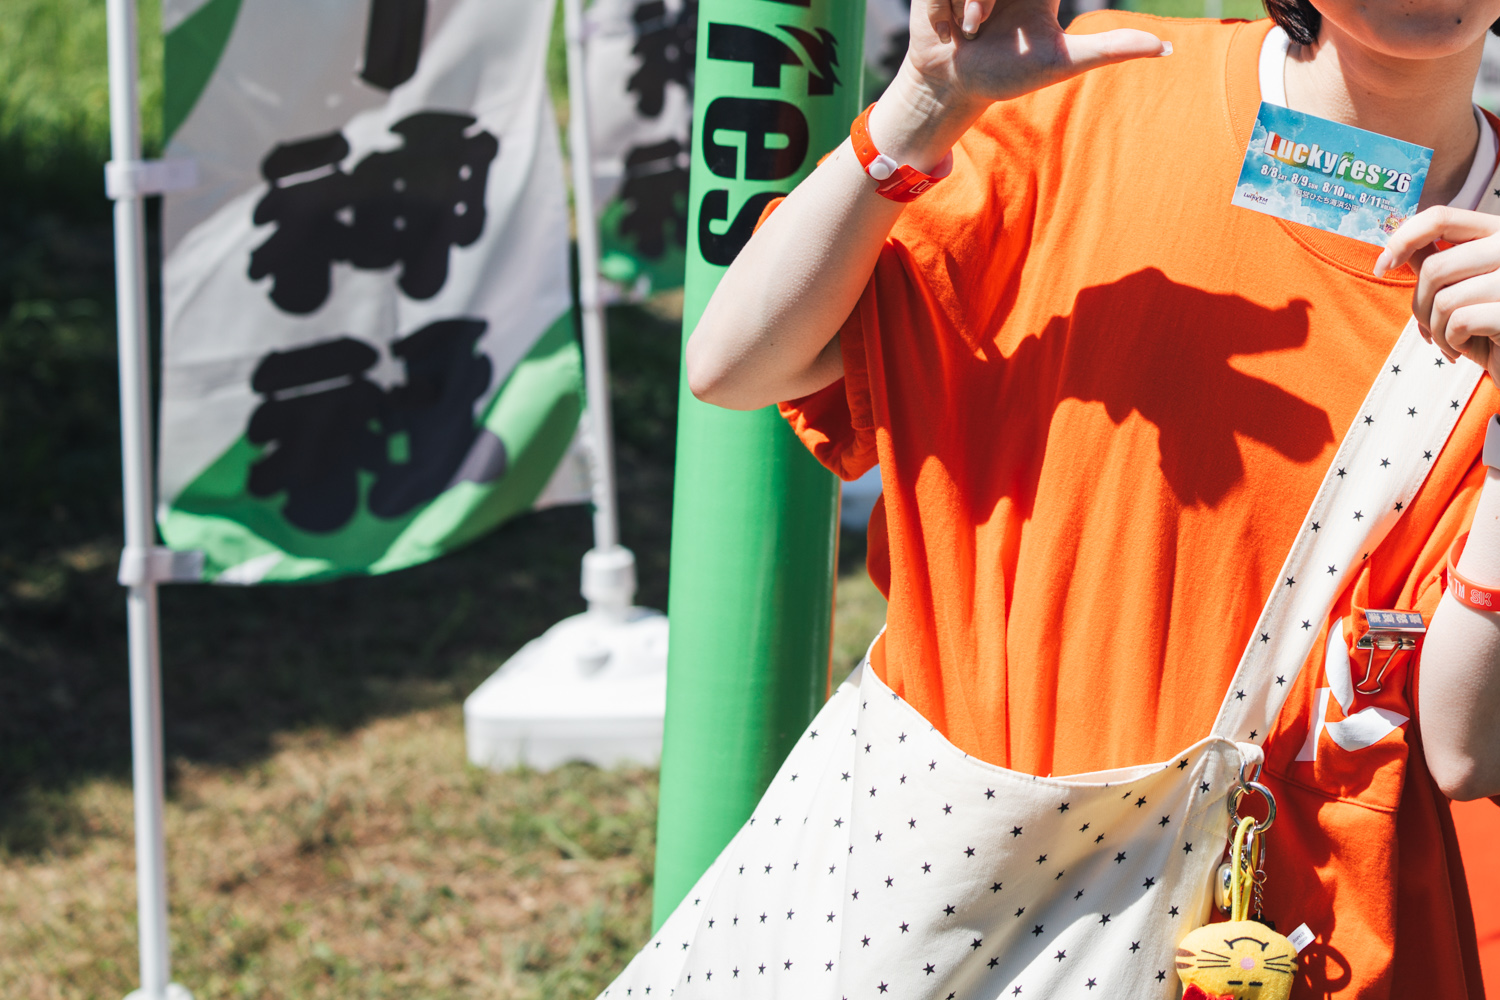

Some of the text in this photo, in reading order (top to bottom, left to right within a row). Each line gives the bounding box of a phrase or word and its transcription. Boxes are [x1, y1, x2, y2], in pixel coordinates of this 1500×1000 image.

[1260, 164, 1278, 178] 8/8
[1291, 173, 1309, 187] 8/9
[1322, 181, 1344, 197] 8/10
[1359, 192, 1382, 208] 8/11
